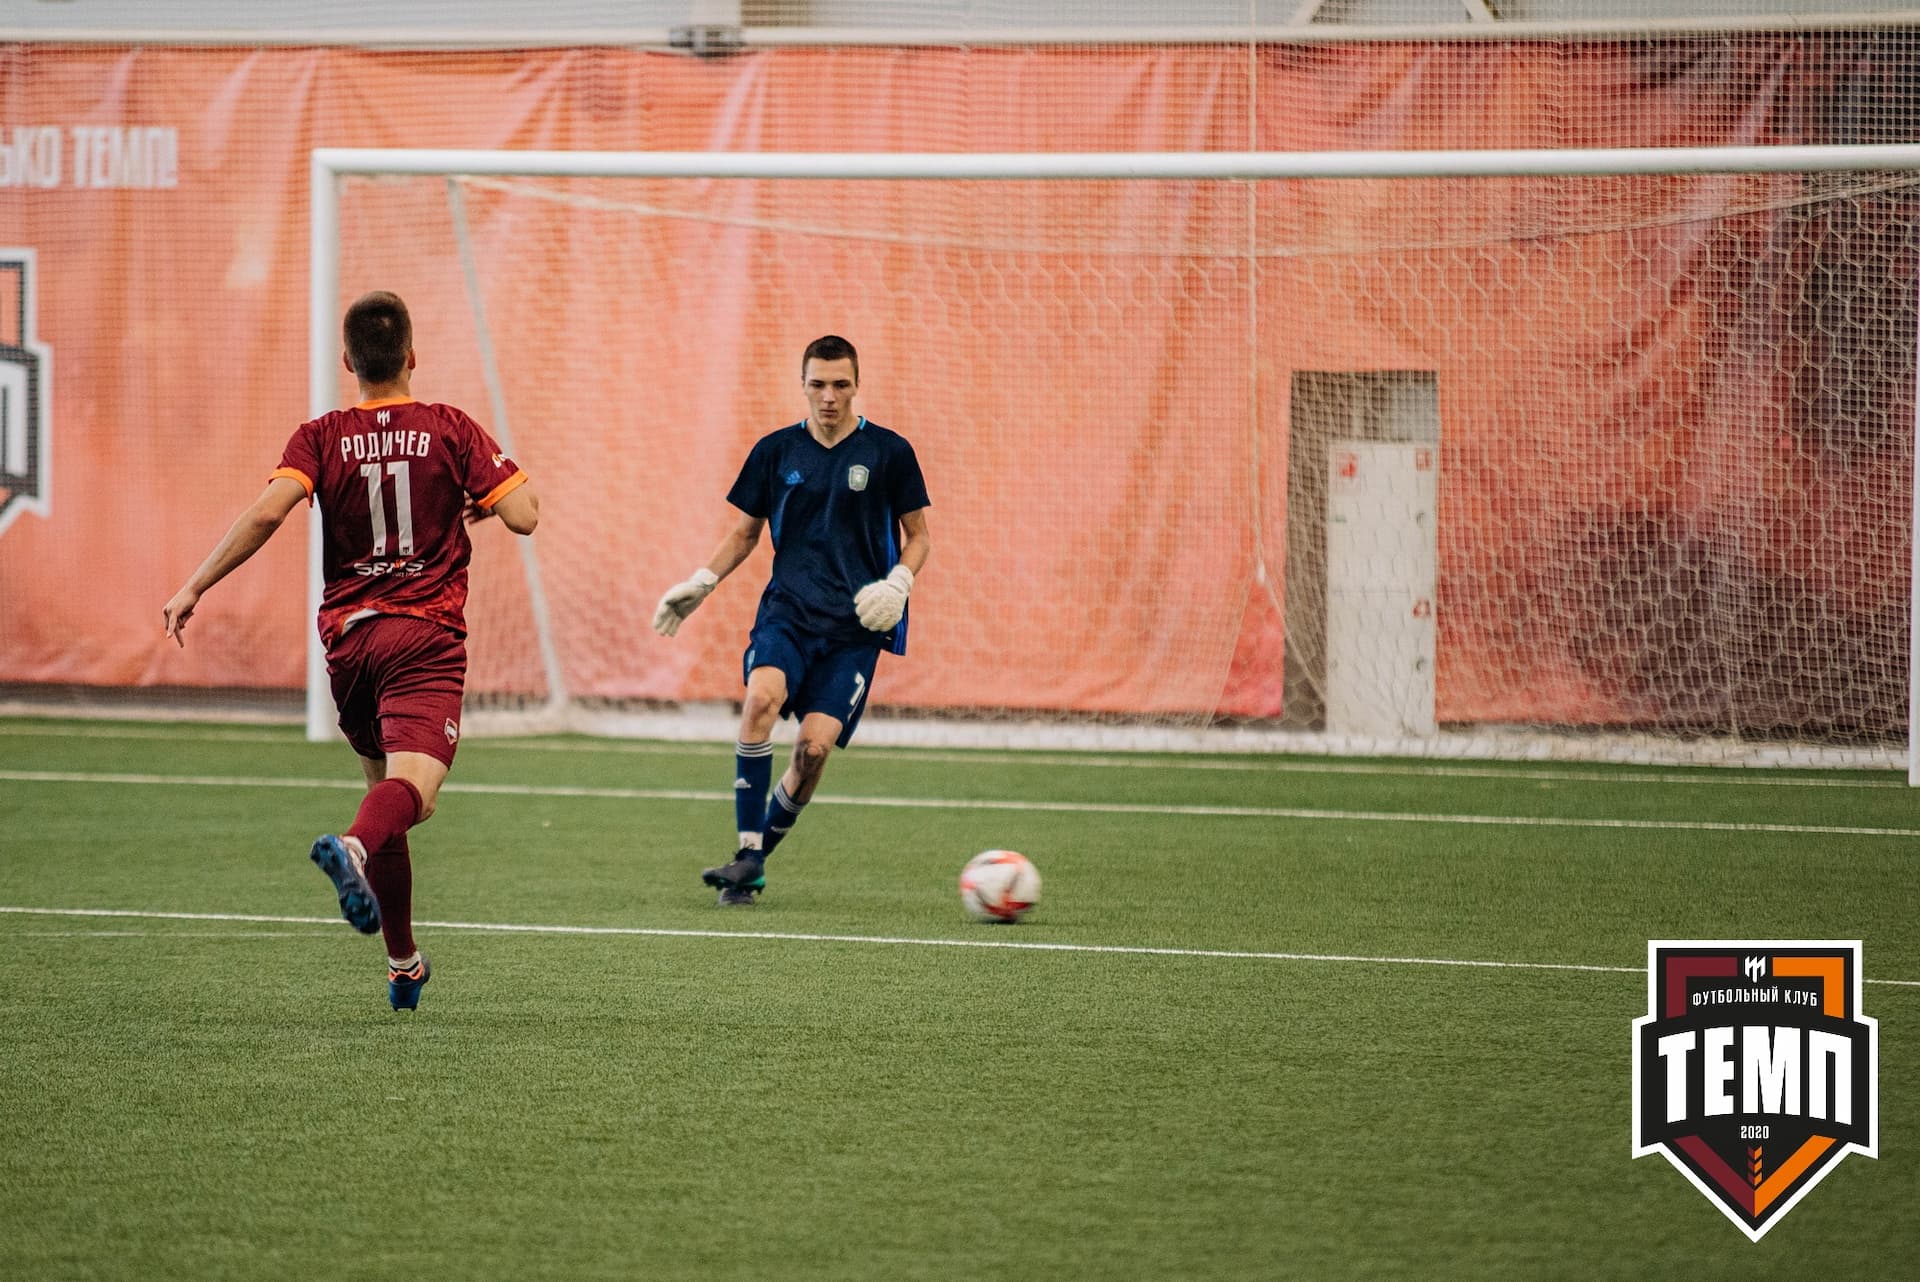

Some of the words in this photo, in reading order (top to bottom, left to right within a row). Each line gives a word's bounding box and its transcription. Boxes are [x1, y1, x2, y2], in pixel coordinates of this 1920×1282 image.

[72, 126, 178, 188] ТЕМП!
[341, 430, 431, 462] РОДИЧЕВ
[360, 460, 414, 557] 11
